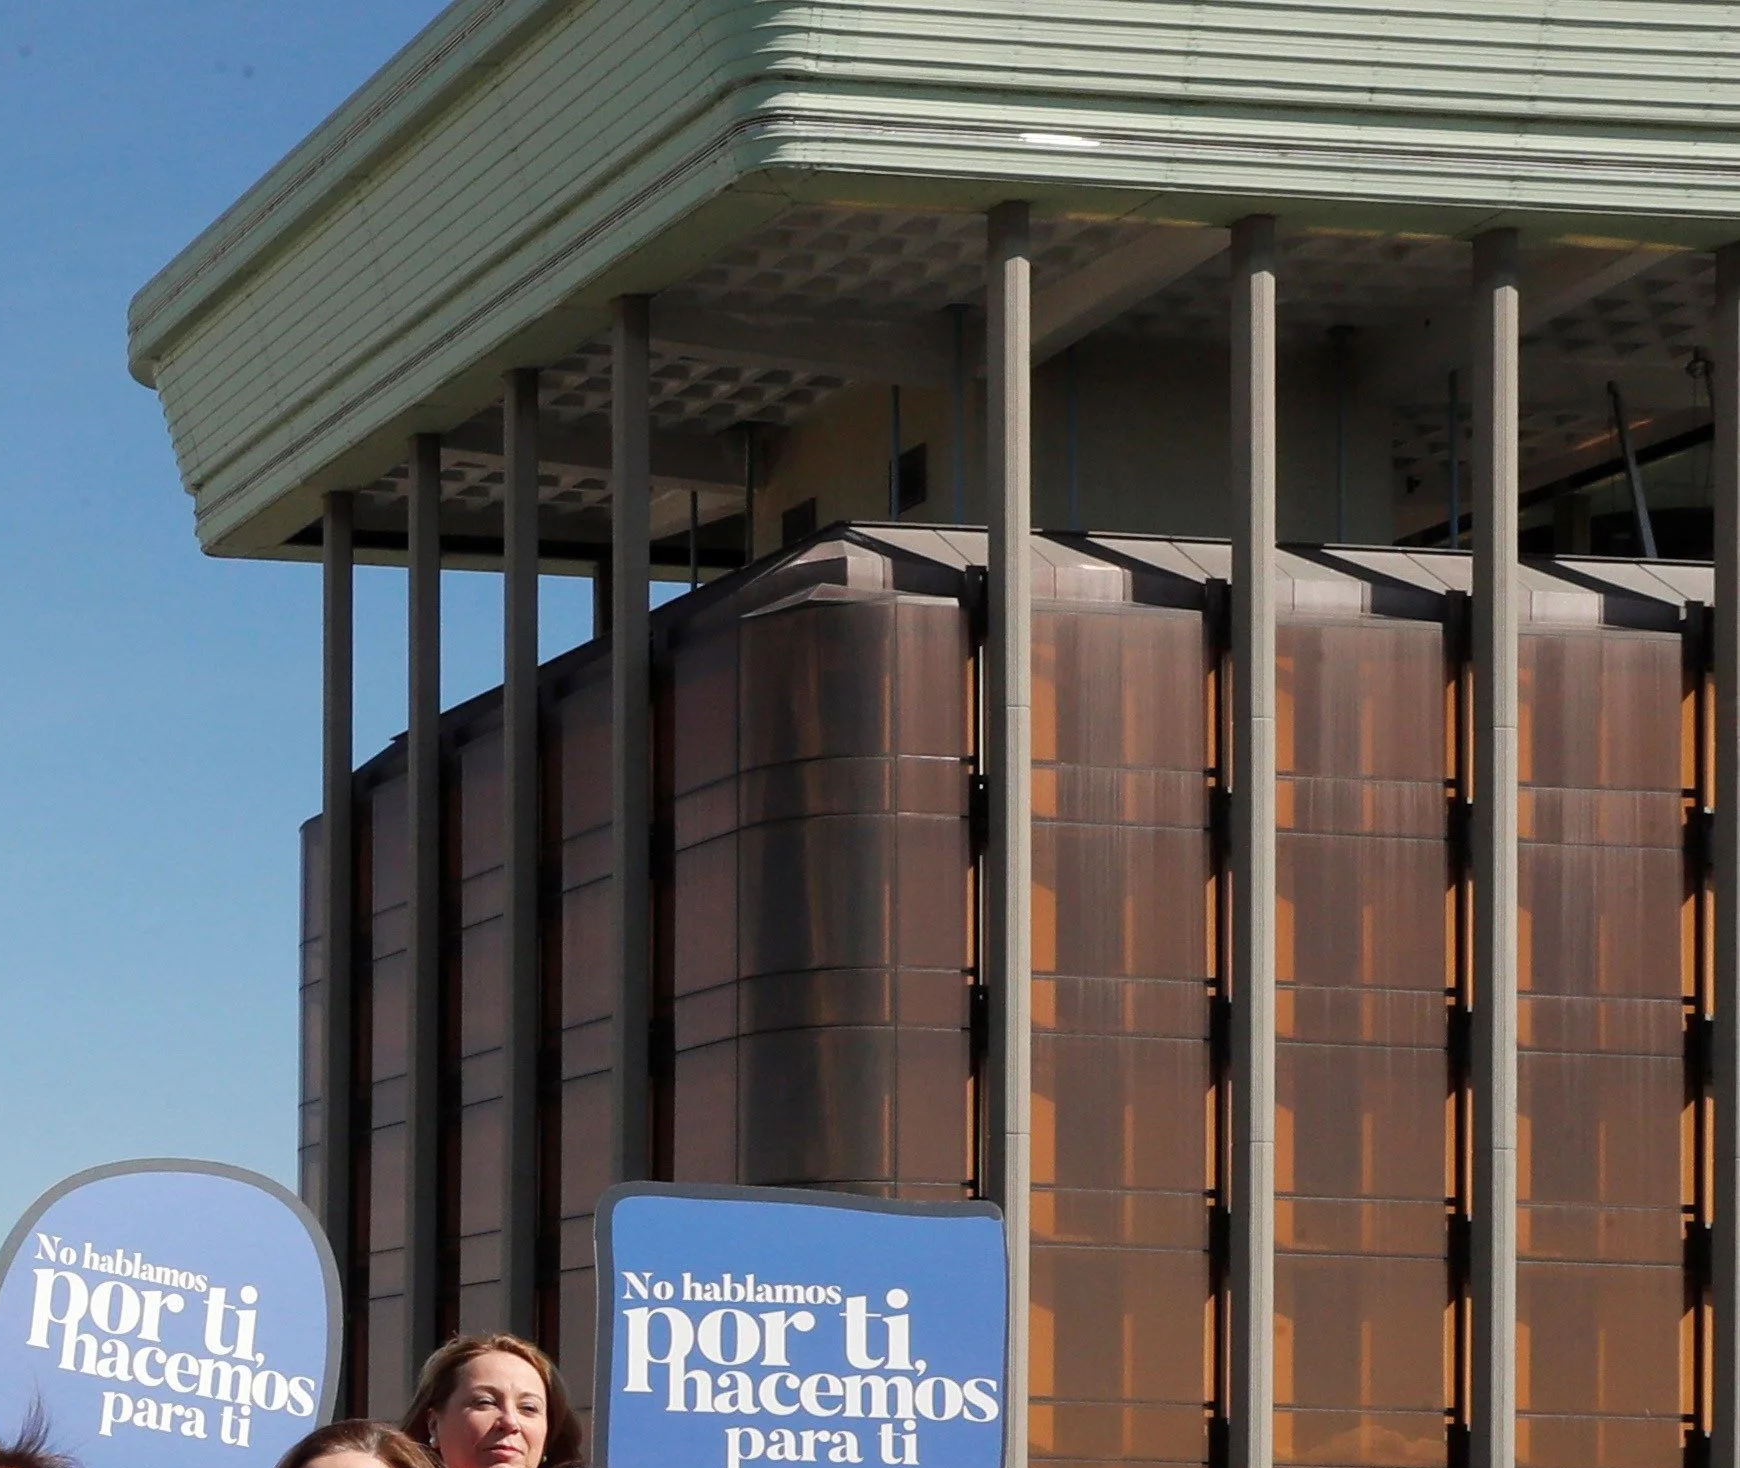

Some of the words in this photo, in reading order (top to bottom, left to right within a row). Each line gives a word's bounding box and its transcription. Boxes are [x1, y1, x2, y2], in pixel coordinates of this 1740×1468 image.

[36, 1232, 77, 1266] No
[83, 1242, 209, 1294] hablamos
[621, 1272, 676, 1302] No
[682, 1272, 843, 1306] hablamos
[26, 1267, 185, 1350] por
[204, 1285, 265, 1369] ti,
[622, 1306, 816, 1394] por
[839, 1288, 928, 1377] ti,
[57, 1322, 315, 1417] hacemos
[665, 1362, 1000, 1424] hacemos
[98, 1391, 208, 1439] para
[221, 1405, 252, 1449] ti
[878, 1420, 920, 1467] ti
